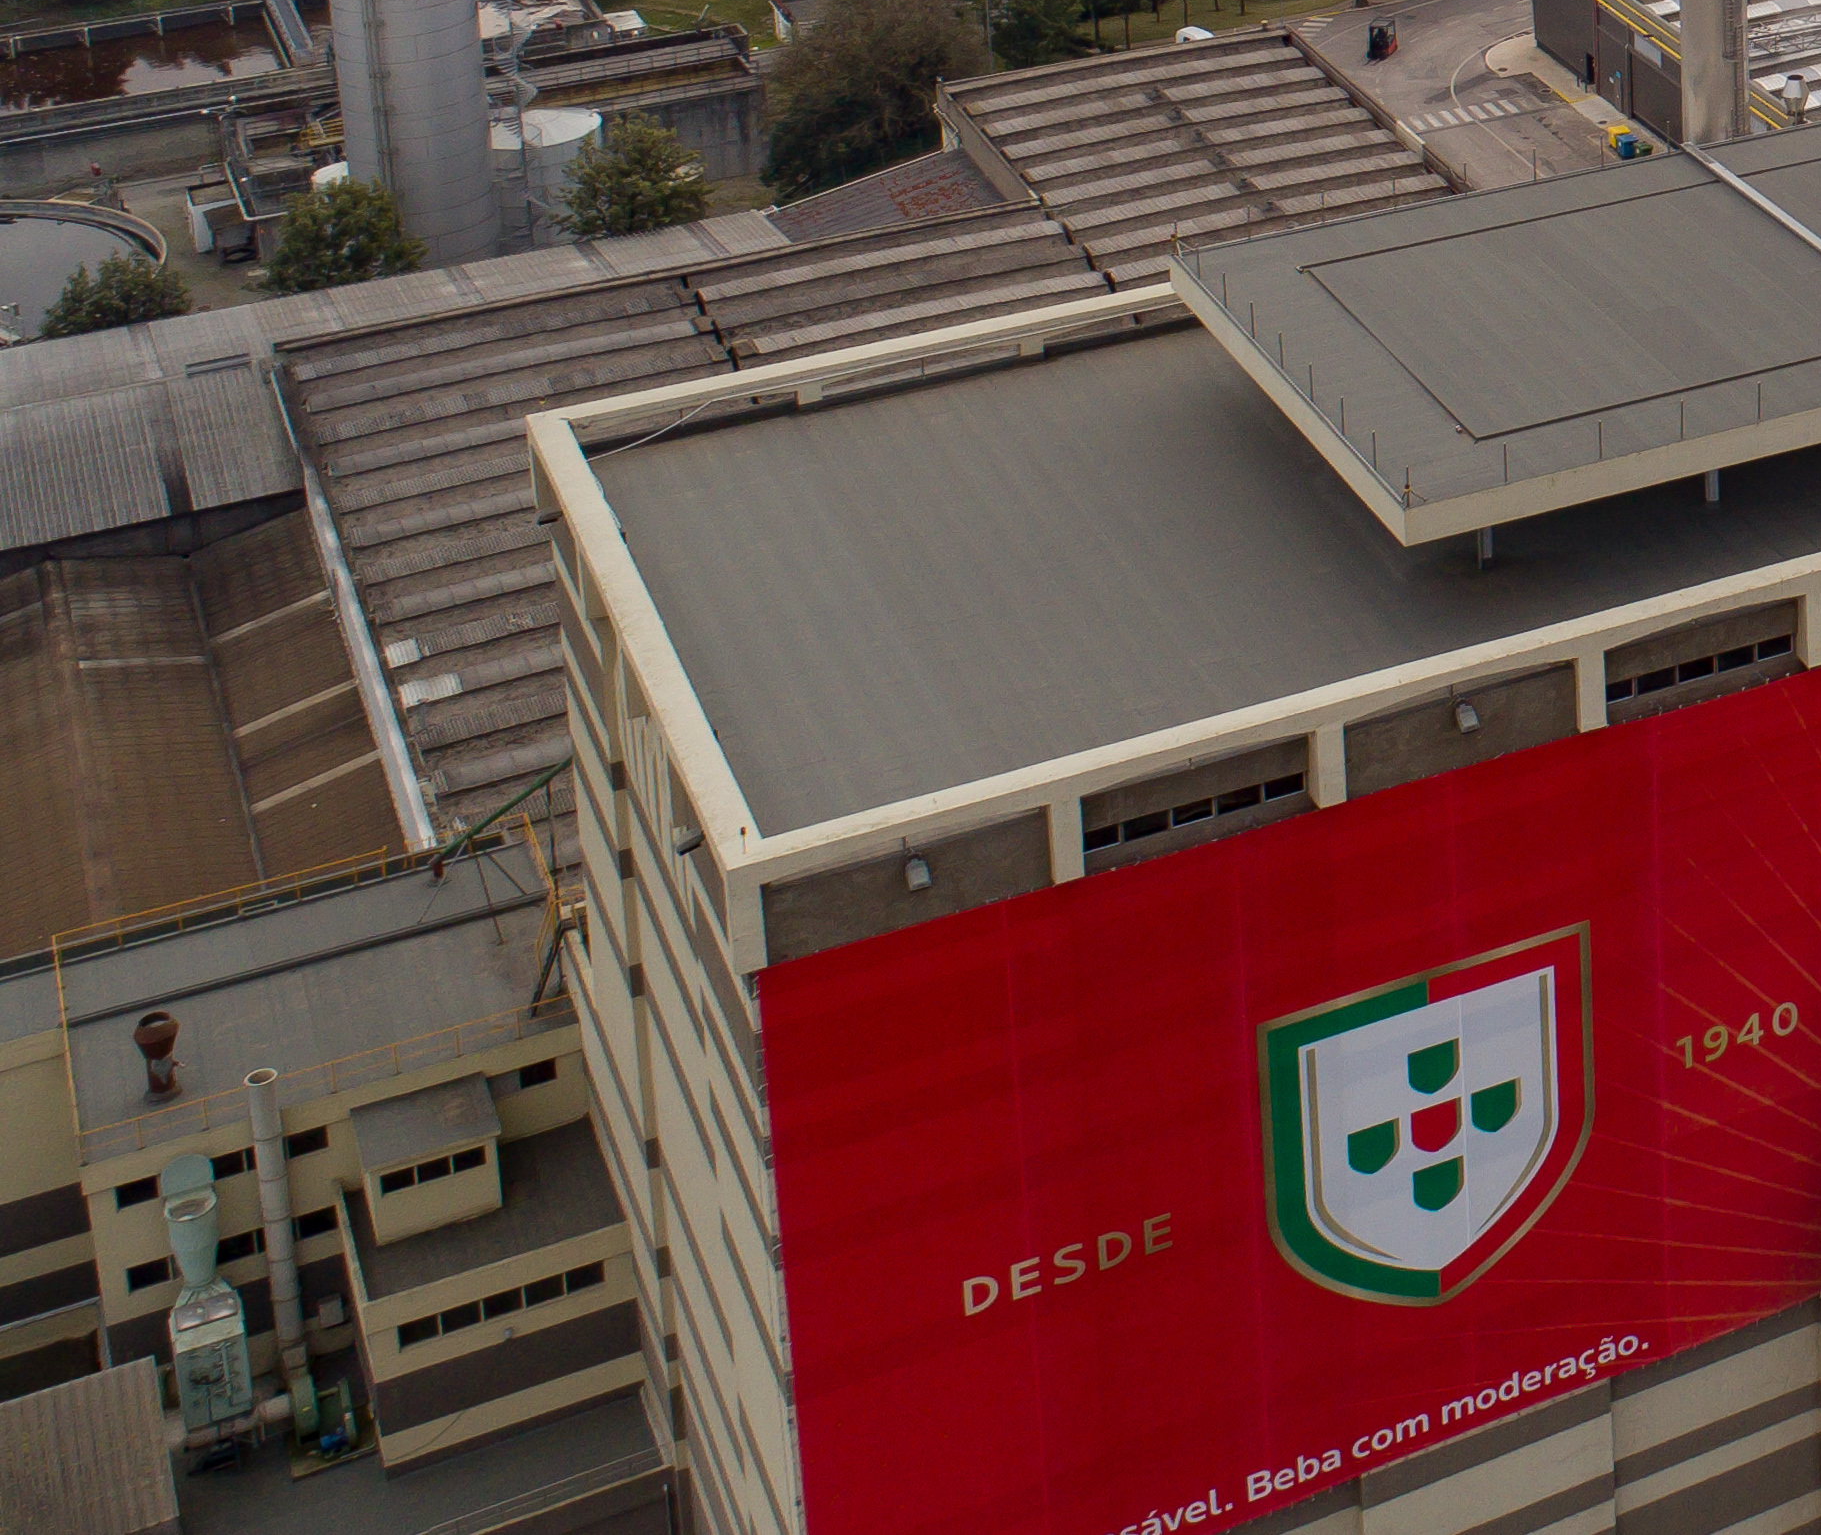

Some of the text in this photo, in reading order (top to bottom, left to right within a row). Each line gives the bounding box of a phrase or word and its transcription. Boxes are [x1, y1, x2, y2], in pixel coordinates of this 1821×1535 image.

[962, 1001, 1799, 1317] DESDE 1940
[1105, 1333, 1650, 1535] sável. Beba com moderação.
